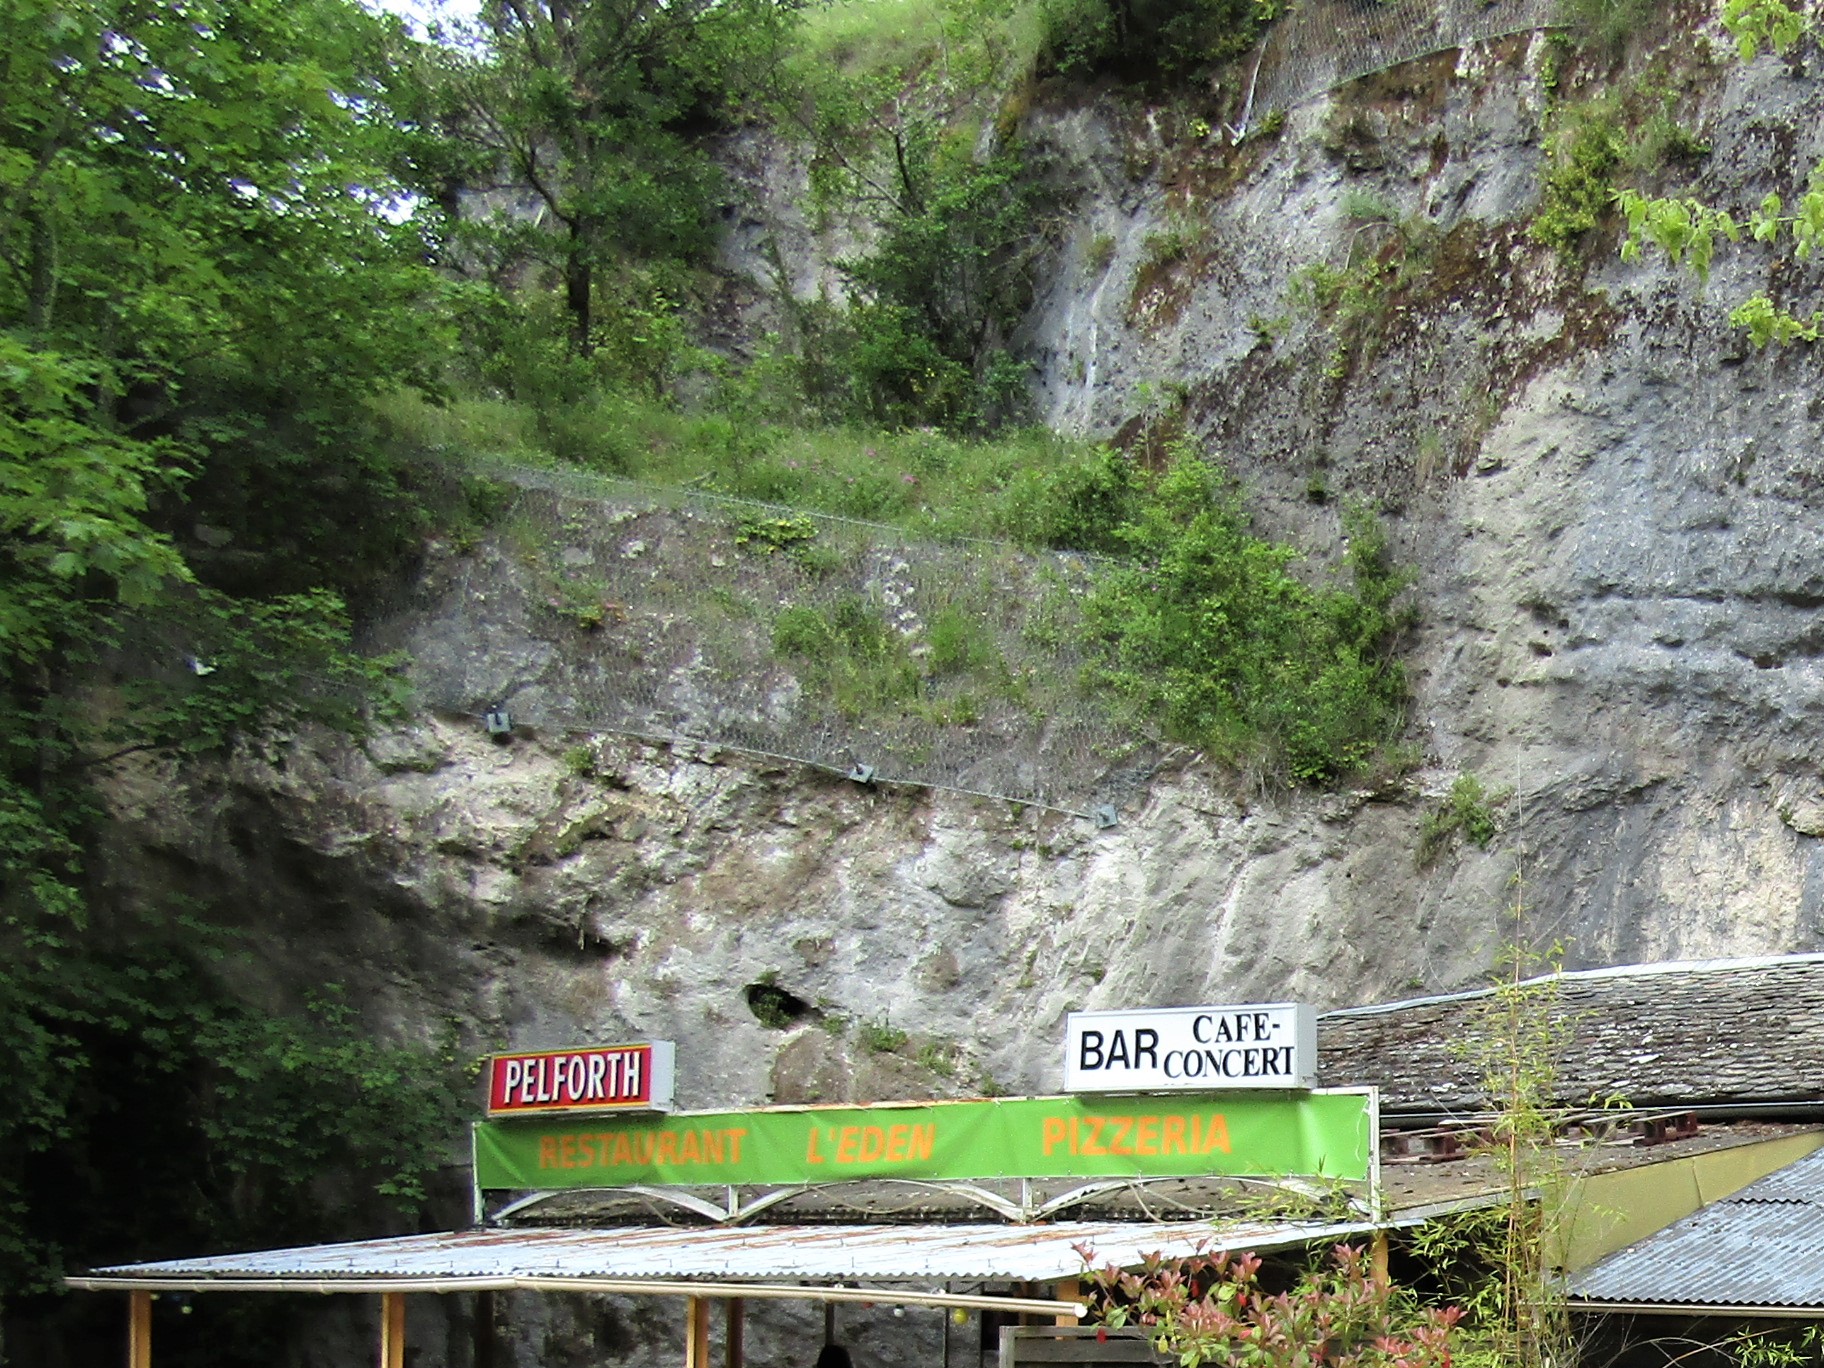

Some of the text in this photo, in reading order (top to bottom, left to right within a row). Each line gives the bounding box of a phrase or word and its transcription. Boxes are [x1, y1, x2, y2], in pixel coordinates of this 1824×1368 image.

[1080, 1028, 1159, 1070] BAR
[1163, 1046, 1295, 1079] CONCERT
[504, 1051, 642, 1105] PELFORTH
[539, 1114, 1231, 1169] RESTAURANT L'EDEN PIZZERIA
